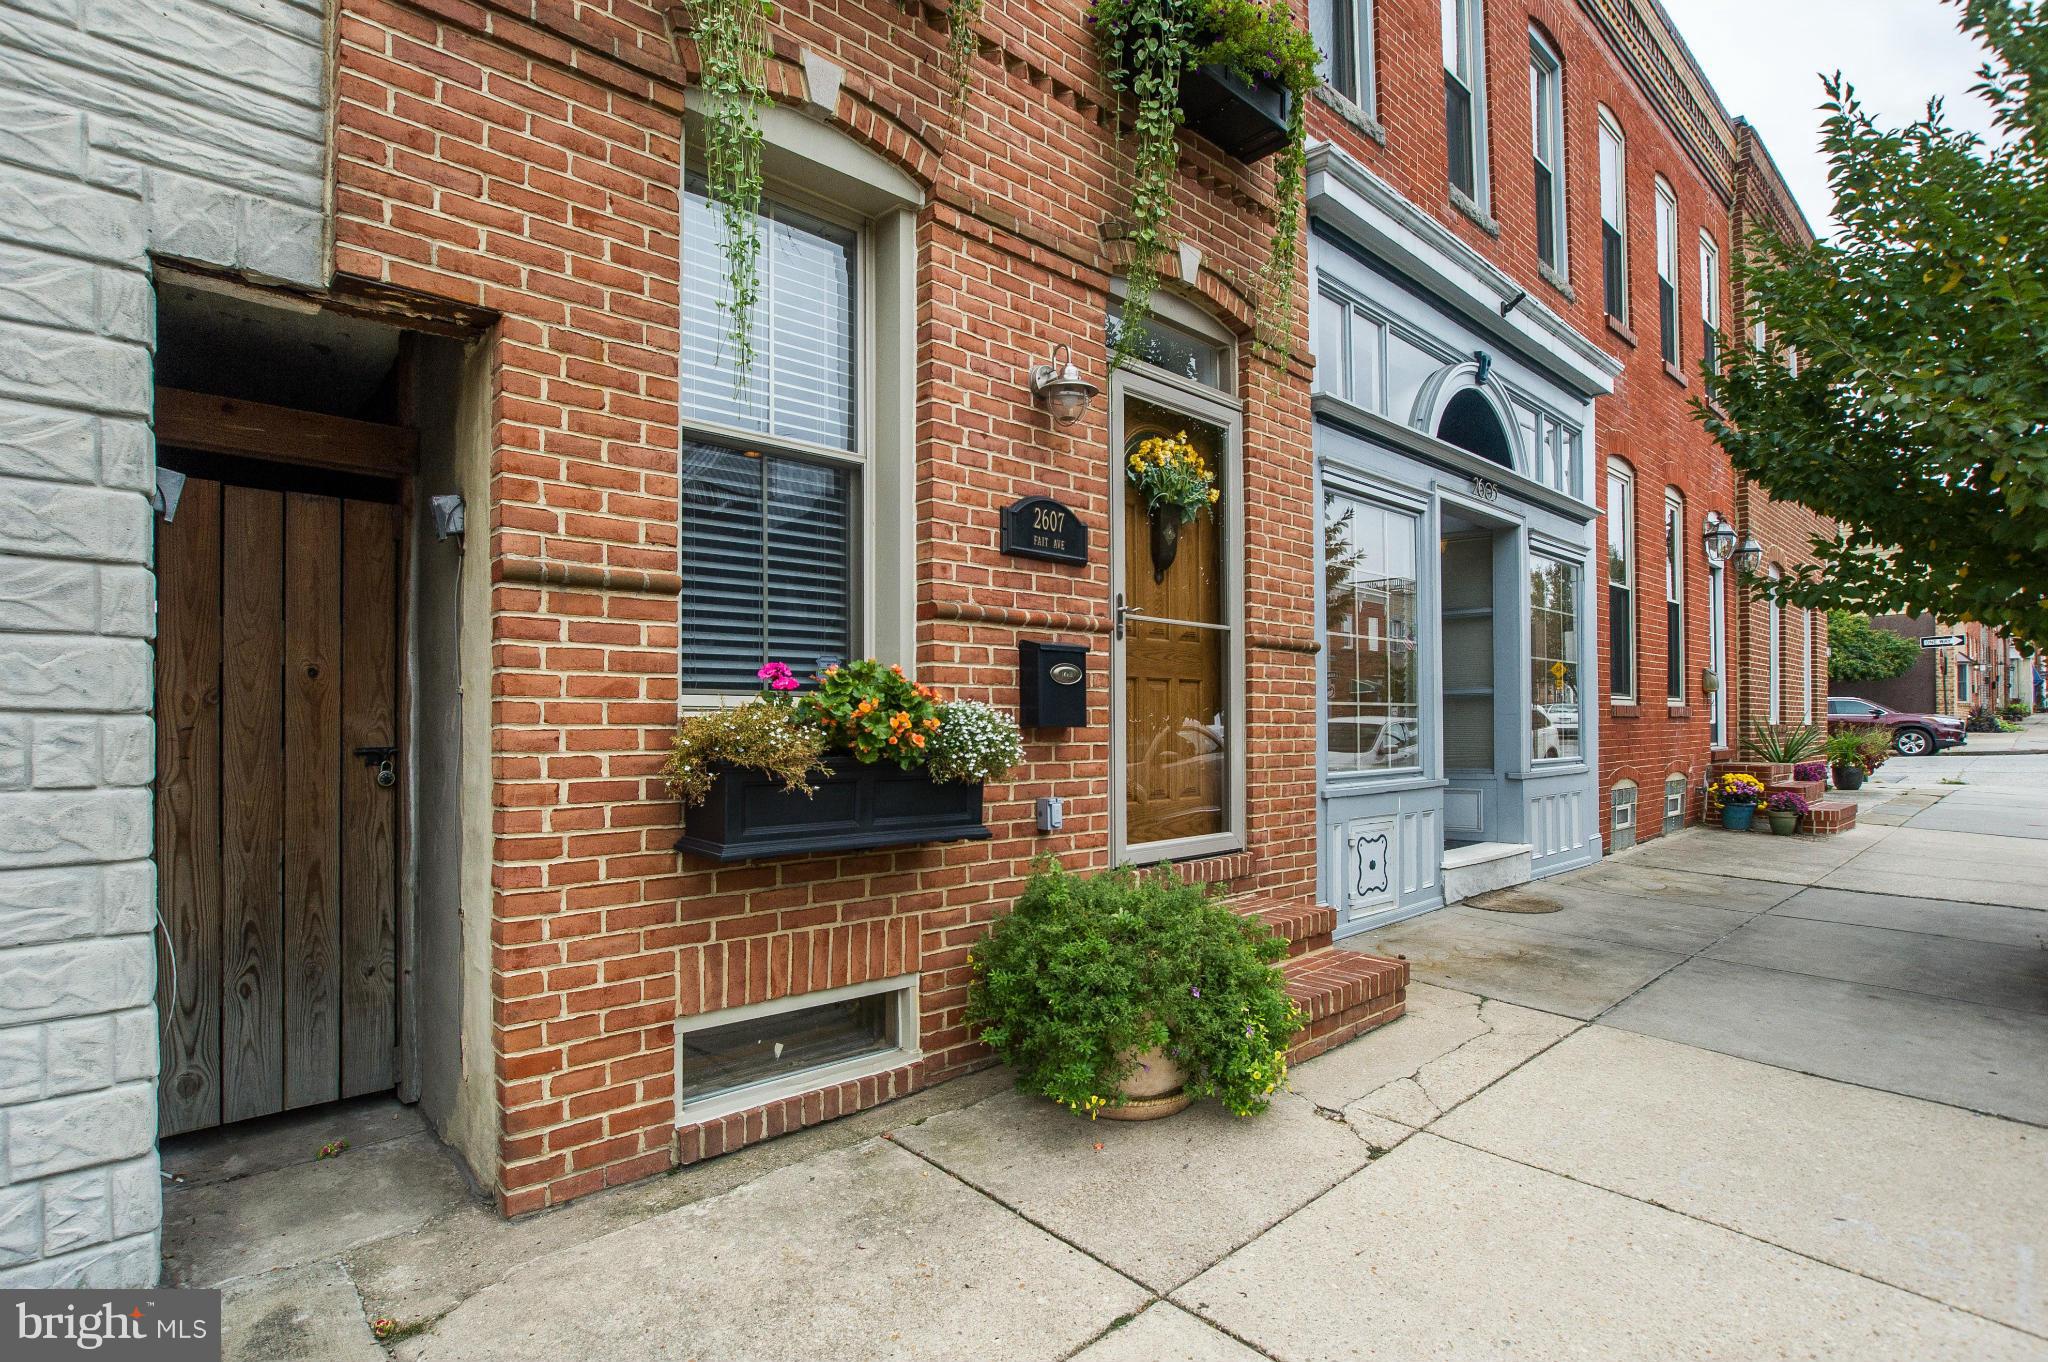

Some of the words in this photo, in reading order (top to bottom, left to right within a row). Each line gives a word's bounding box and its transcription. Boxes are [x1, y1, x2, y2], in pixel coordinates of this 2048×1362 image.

[1473, 477, 1498, 501] 2605
[1033, 507, 1065, 533] 2607
[1033, 535, 1049, 547] FAIT
[1053, 539, 1065, 550] AVE
